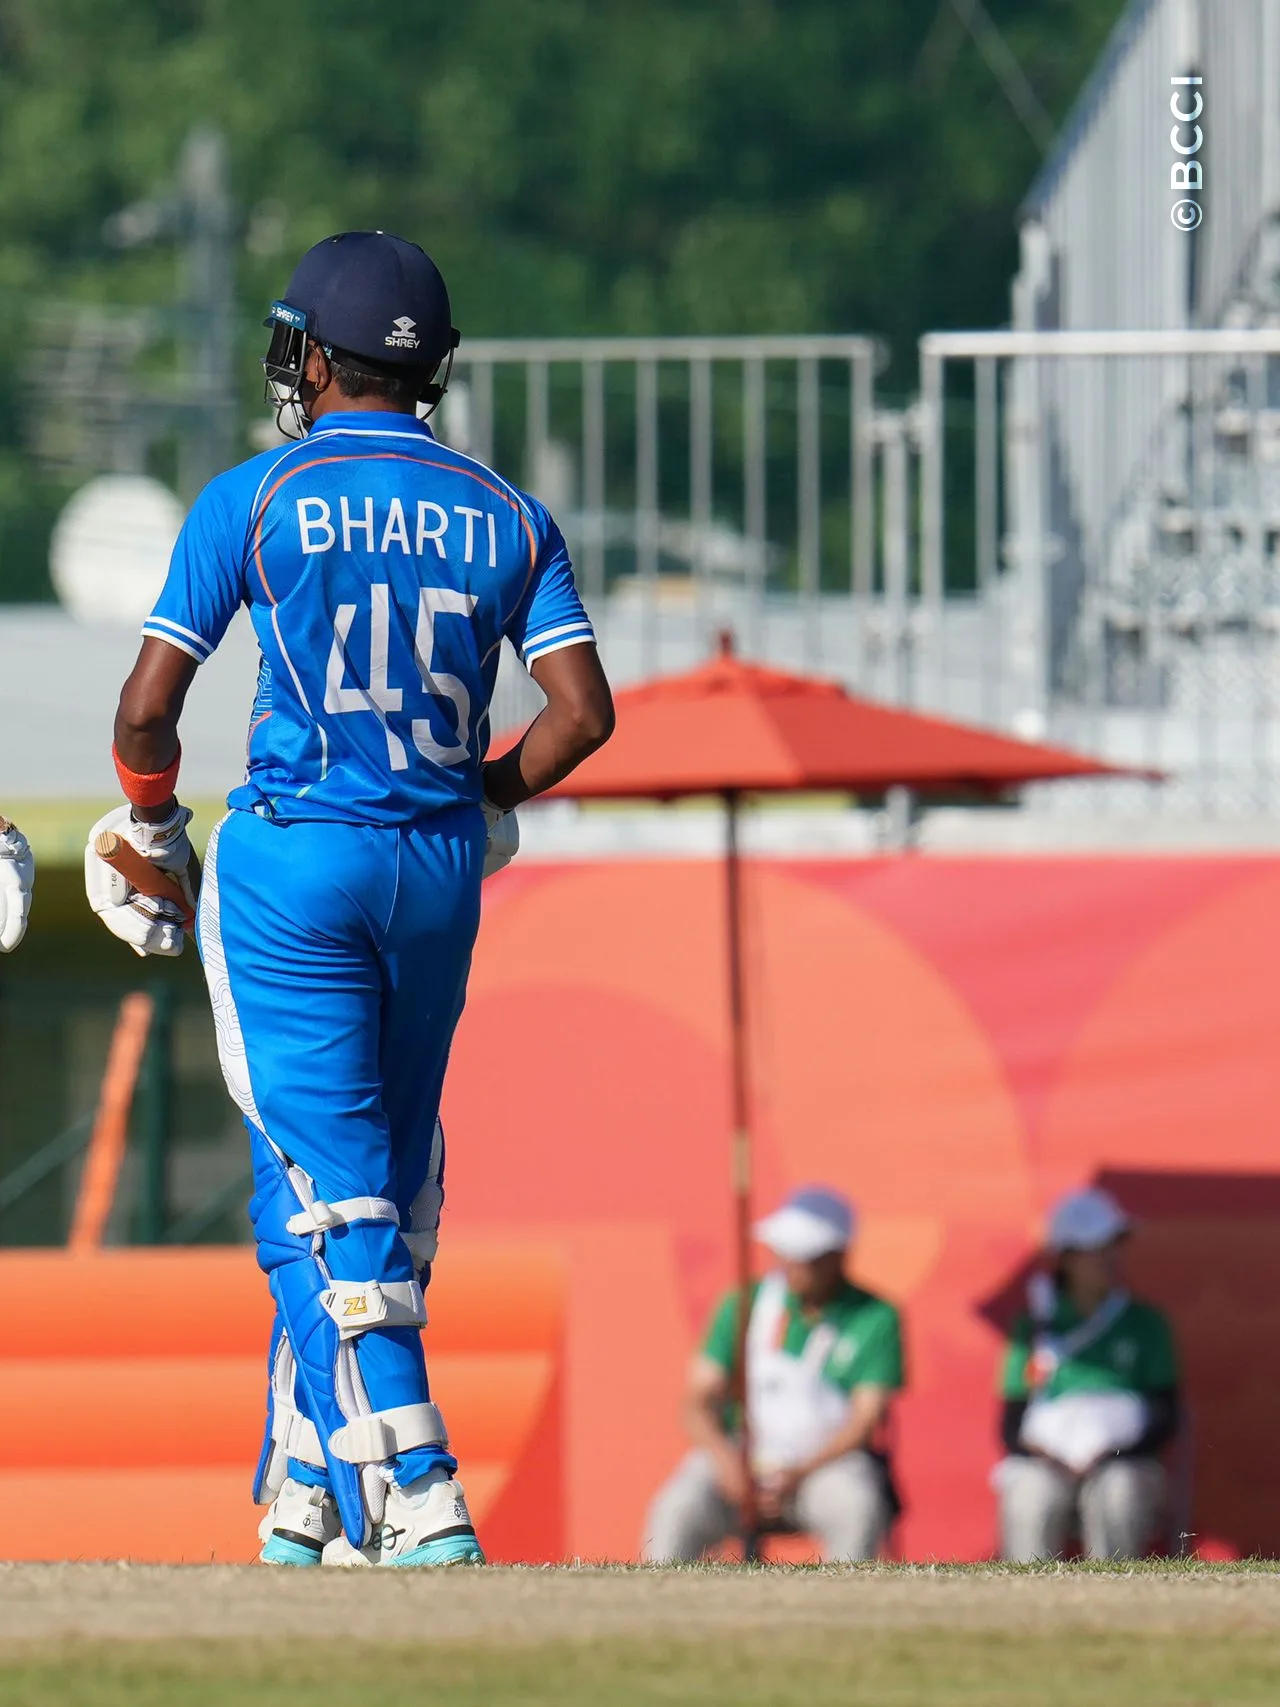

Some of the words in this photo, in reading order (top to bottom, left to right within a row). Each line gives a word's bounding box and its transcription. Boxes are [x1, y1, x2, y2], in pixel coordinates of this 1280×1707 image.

[384, 336, 421, 349] SHREY
[296, 496, 497, 568] BHARTI
[323, 583, 479, 772] 45
